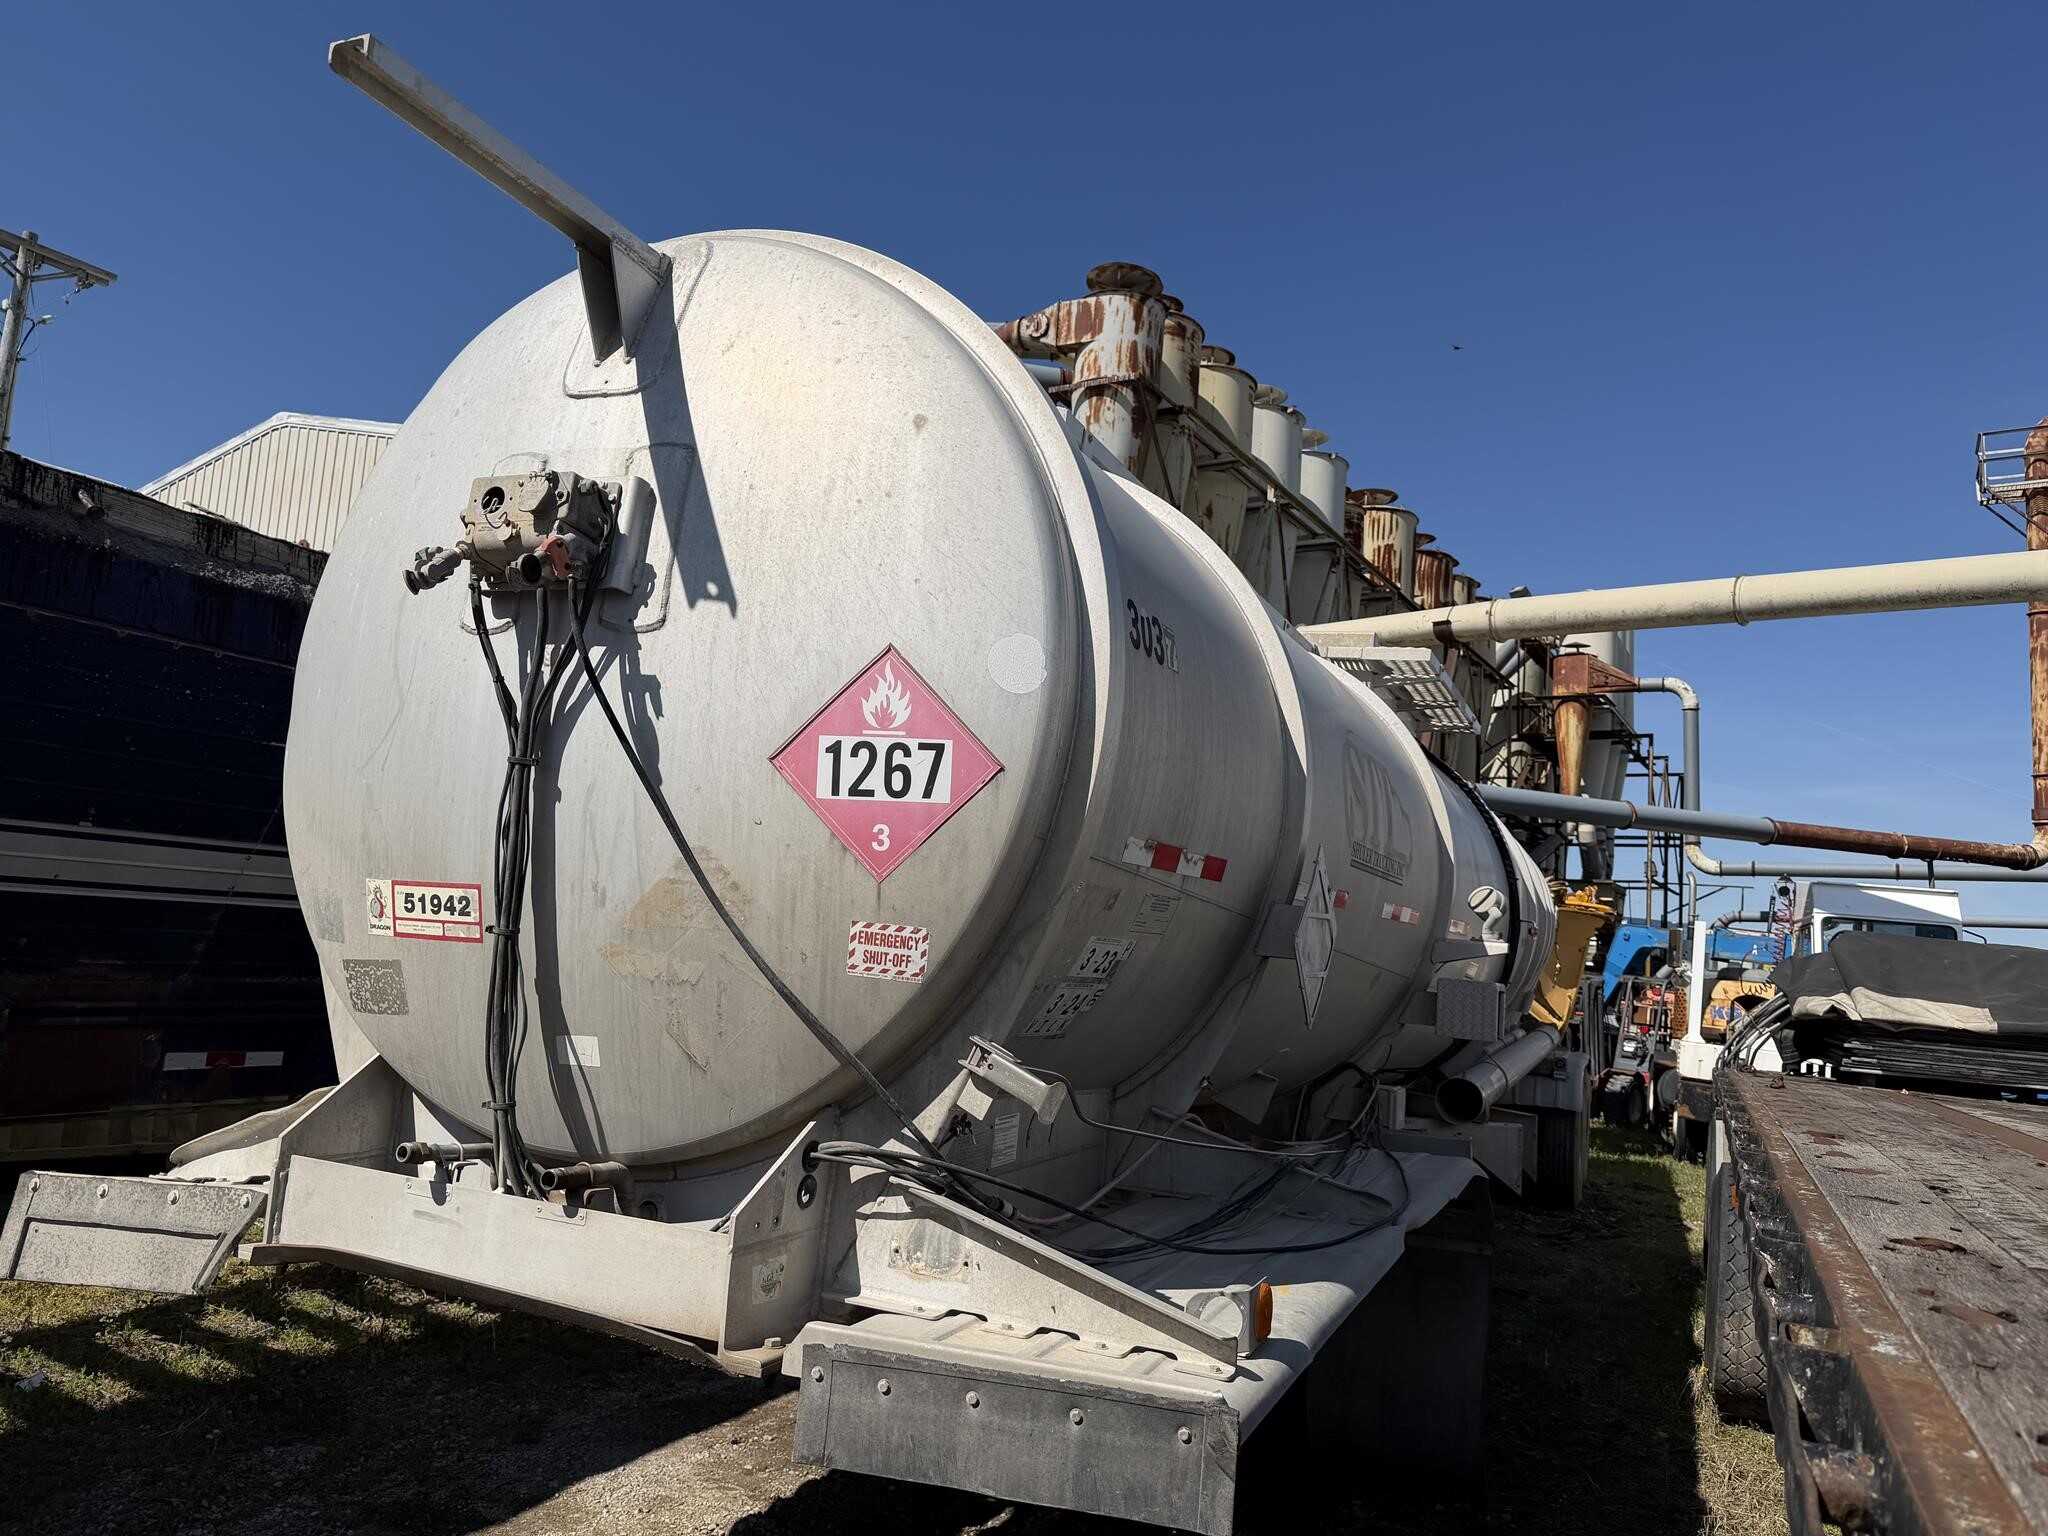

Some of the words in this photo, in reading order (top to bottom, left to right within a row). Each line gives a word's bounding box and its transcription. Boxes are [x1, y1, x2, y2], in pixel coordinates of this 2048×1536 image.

[824, 739, 946, 799] 1267
[871, 823, 891, 852] 3
[403, 892, 472, 916] 51942
[369, 923, 391, 931] DRAGON
[857, 930, 921, 951] EMERGENCY
[862, 949, 912, 969] SHUT-OFF
